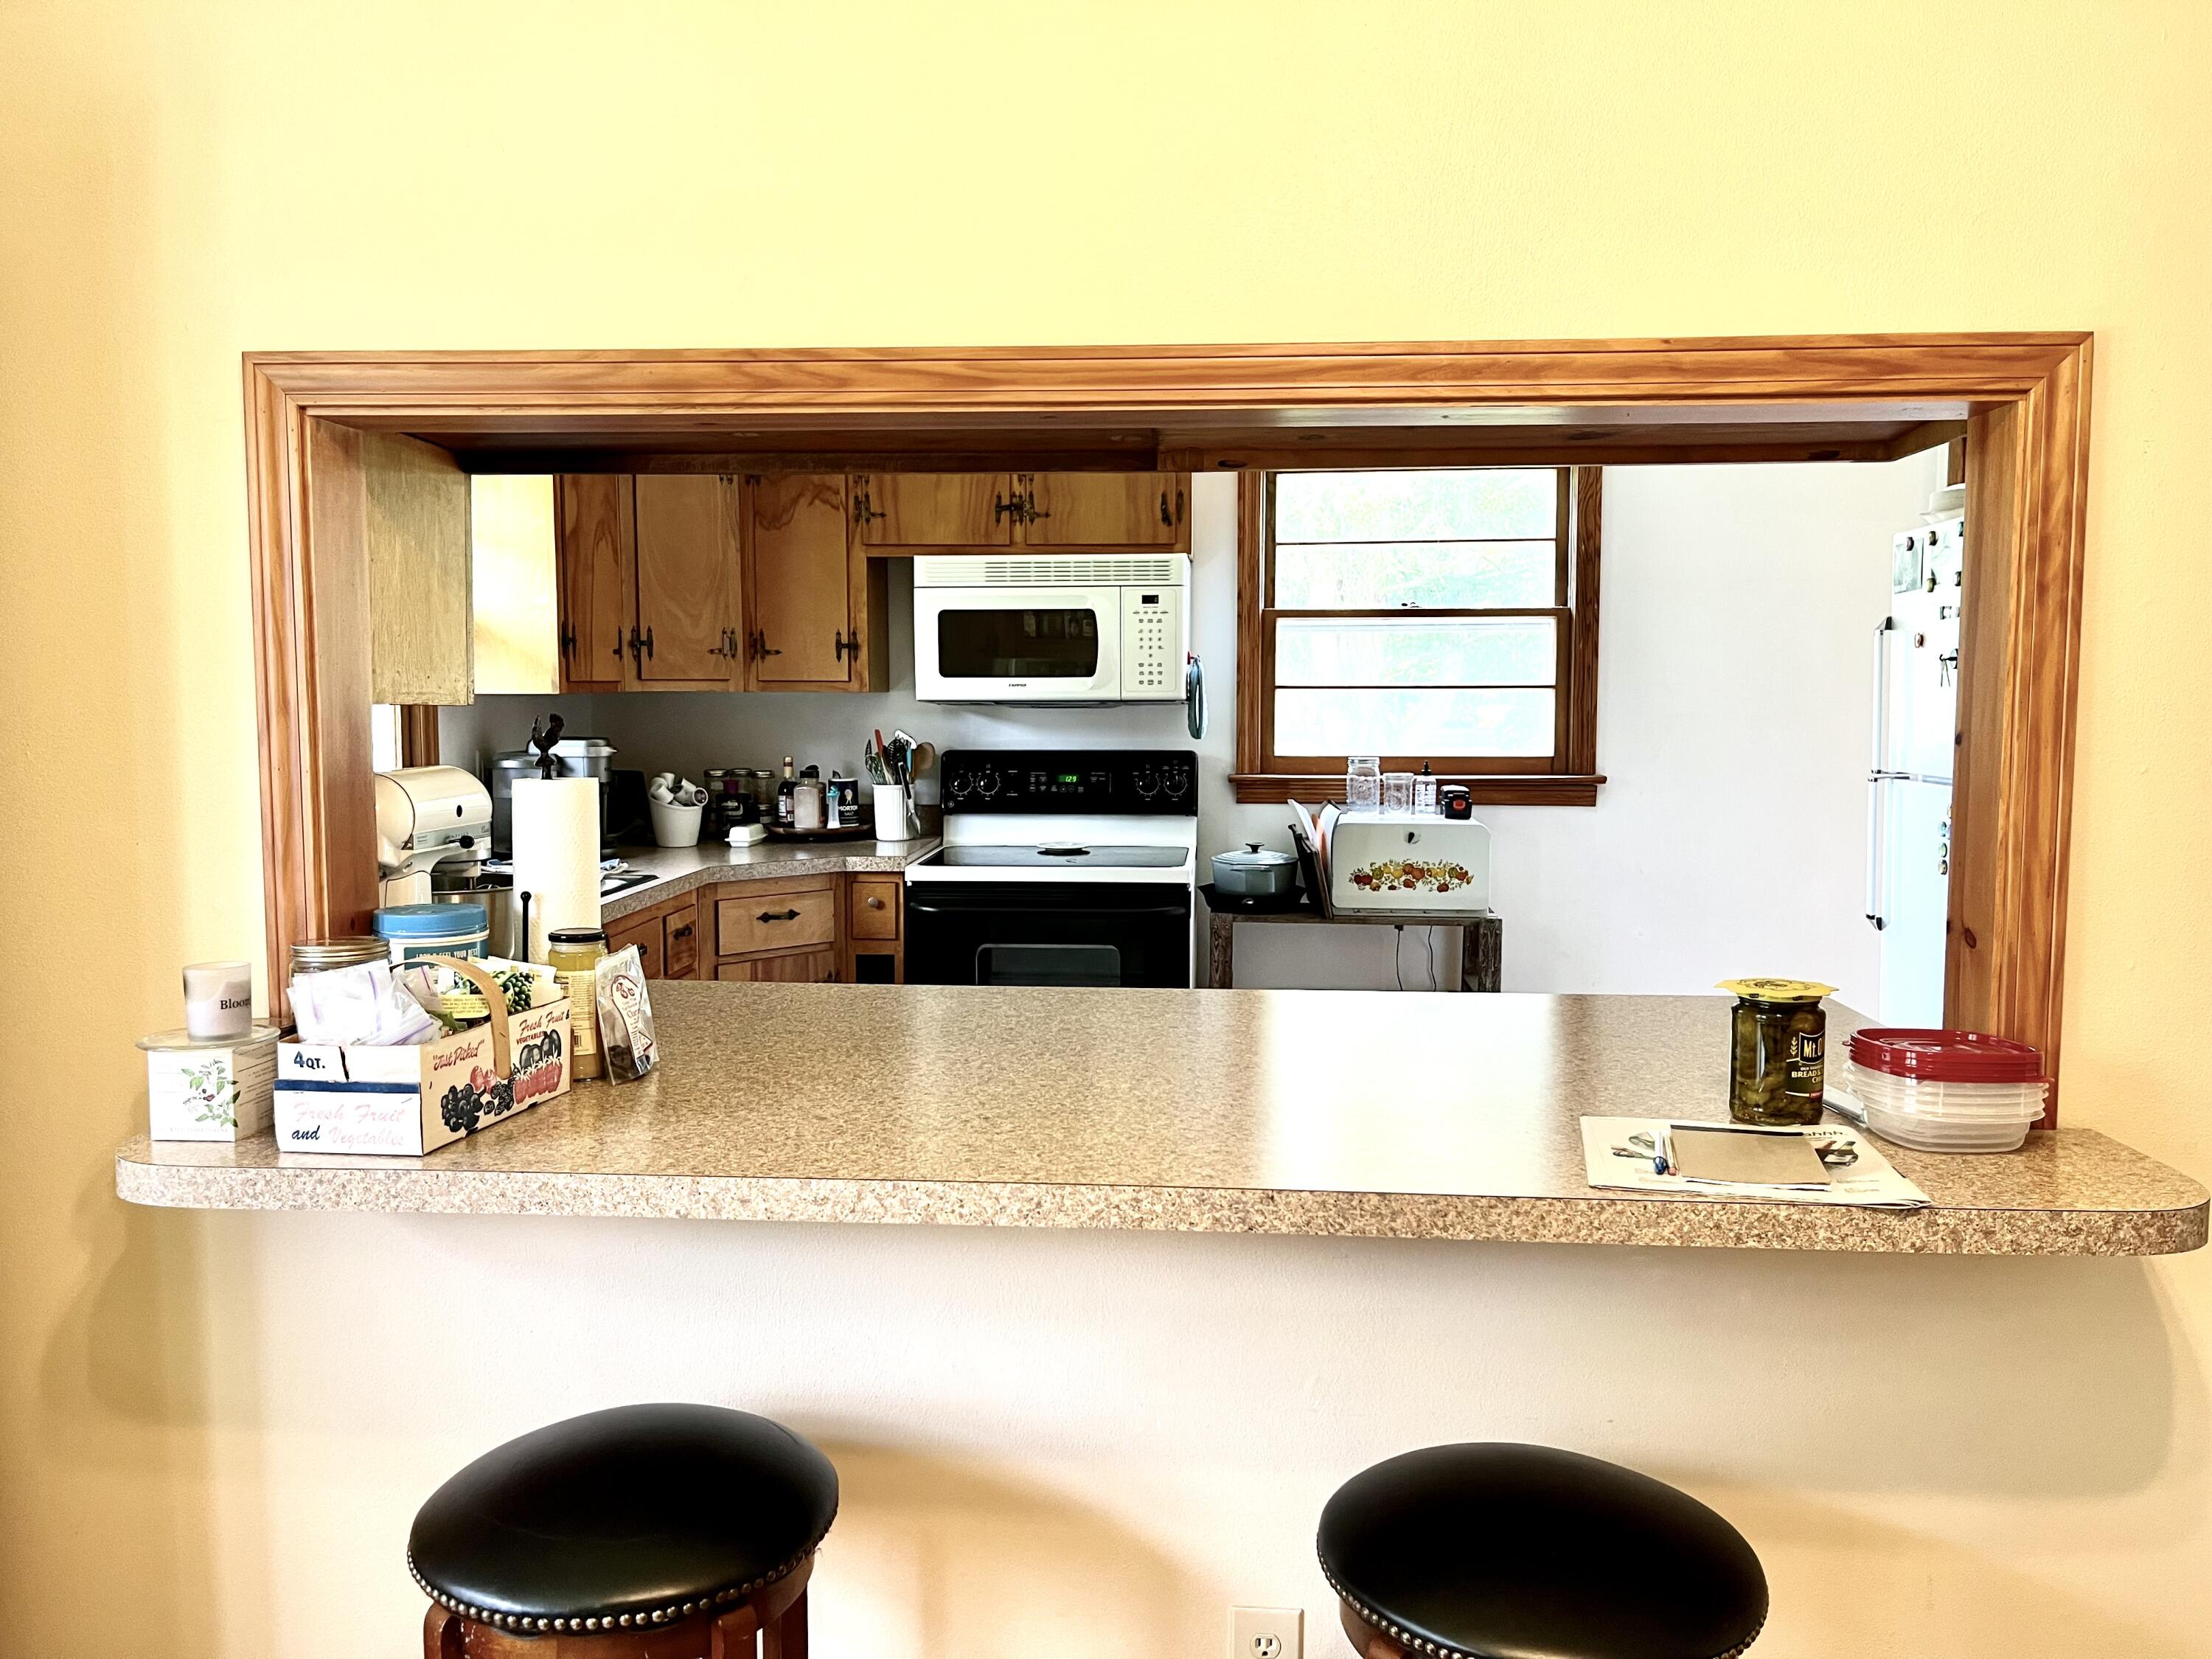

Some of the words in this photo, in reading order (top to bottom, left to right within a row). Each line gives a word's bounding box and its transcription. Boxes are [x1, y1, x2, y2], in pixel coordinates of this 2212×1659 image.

[453, 950, 467, 959] YOUR
[519, 1015, 542, 1036] Fresh
[546, 1011, 563, 1032] Fruit
[516, 1031, 545, 1045] VEGETABLES
[293, 1101, 344, 1122] Fresh
[355, 1104, 406, 1123] Fruit
[291, 1124, 320, 1141] and
[328, 1127, 404, 1149] Vegetables
